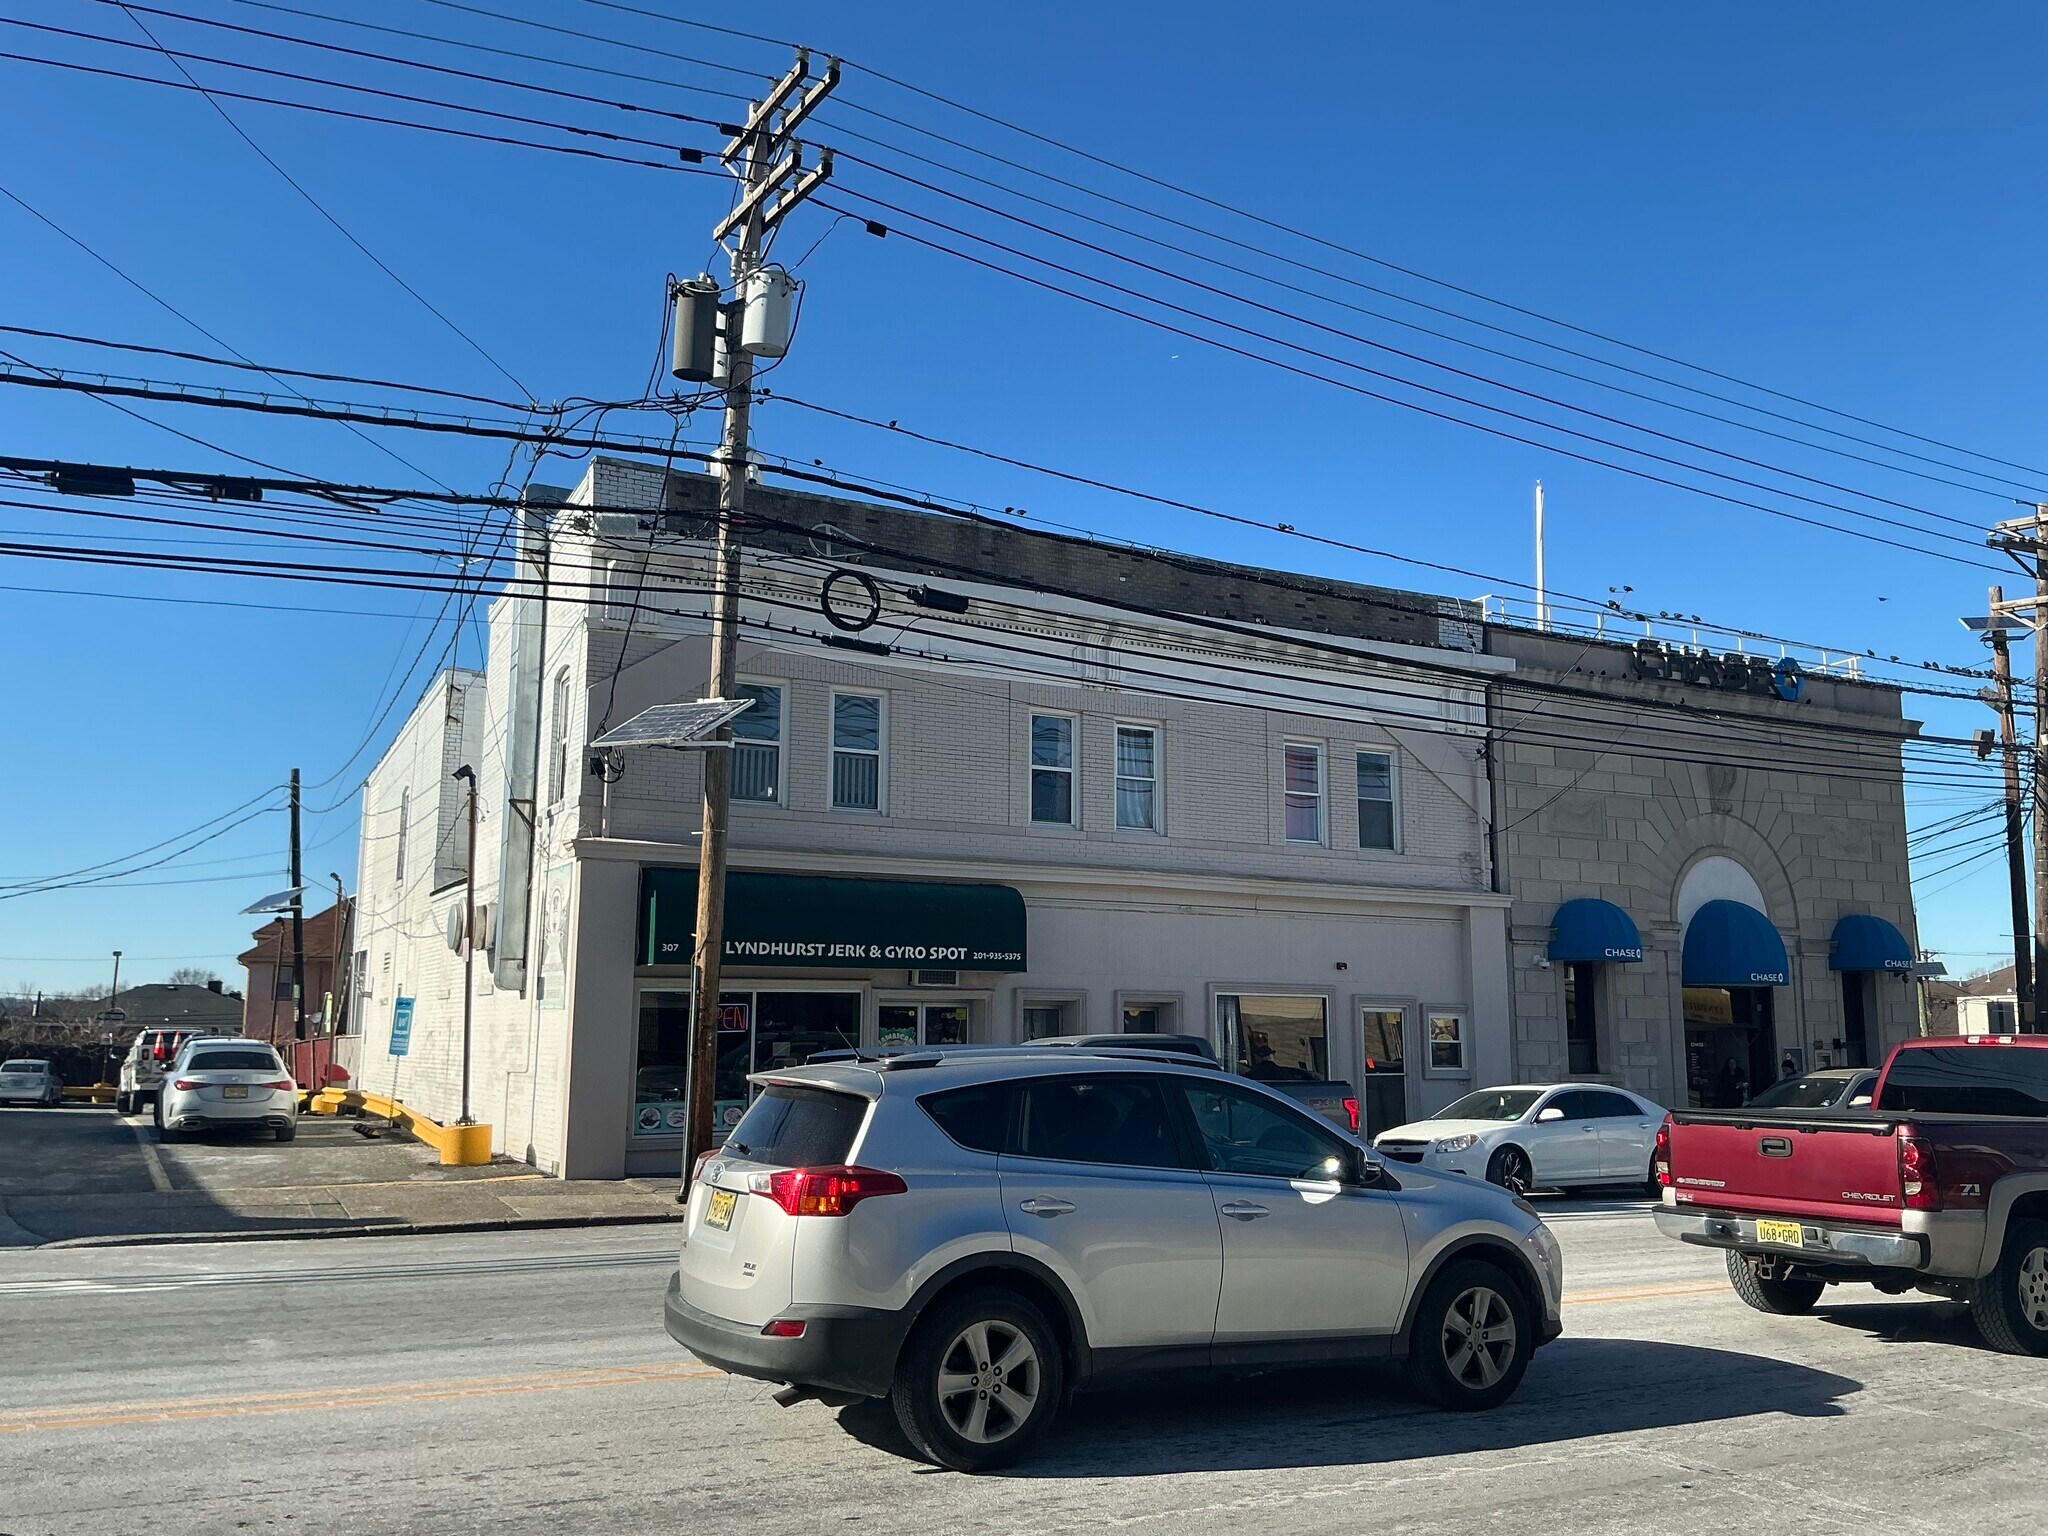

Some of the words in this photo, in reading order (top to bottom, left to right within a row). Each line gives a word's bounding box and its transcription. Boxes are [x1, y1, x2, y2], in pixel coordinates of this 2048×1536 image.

[1632, 638, 1776, 698] CHASE
[661, 943, 679, 952] 307
[725, 941, 826, 957] LYNDHURST
[827, 944, 866, 958] JERK
[869, 944, 882, 958] &
[884, 945, 927, 959] GYRO
[929, 947, 968, 960] SPOT
[973, 951, 1022, 961] 201-935-5375
[1604, 948, 1636, 958] CHASE
[1884, 959, 1910, 968] CHASE
[1750, 973, 1778, 982] CHASE
[1842, 1191, 1895, 1202] CHEVROLET
